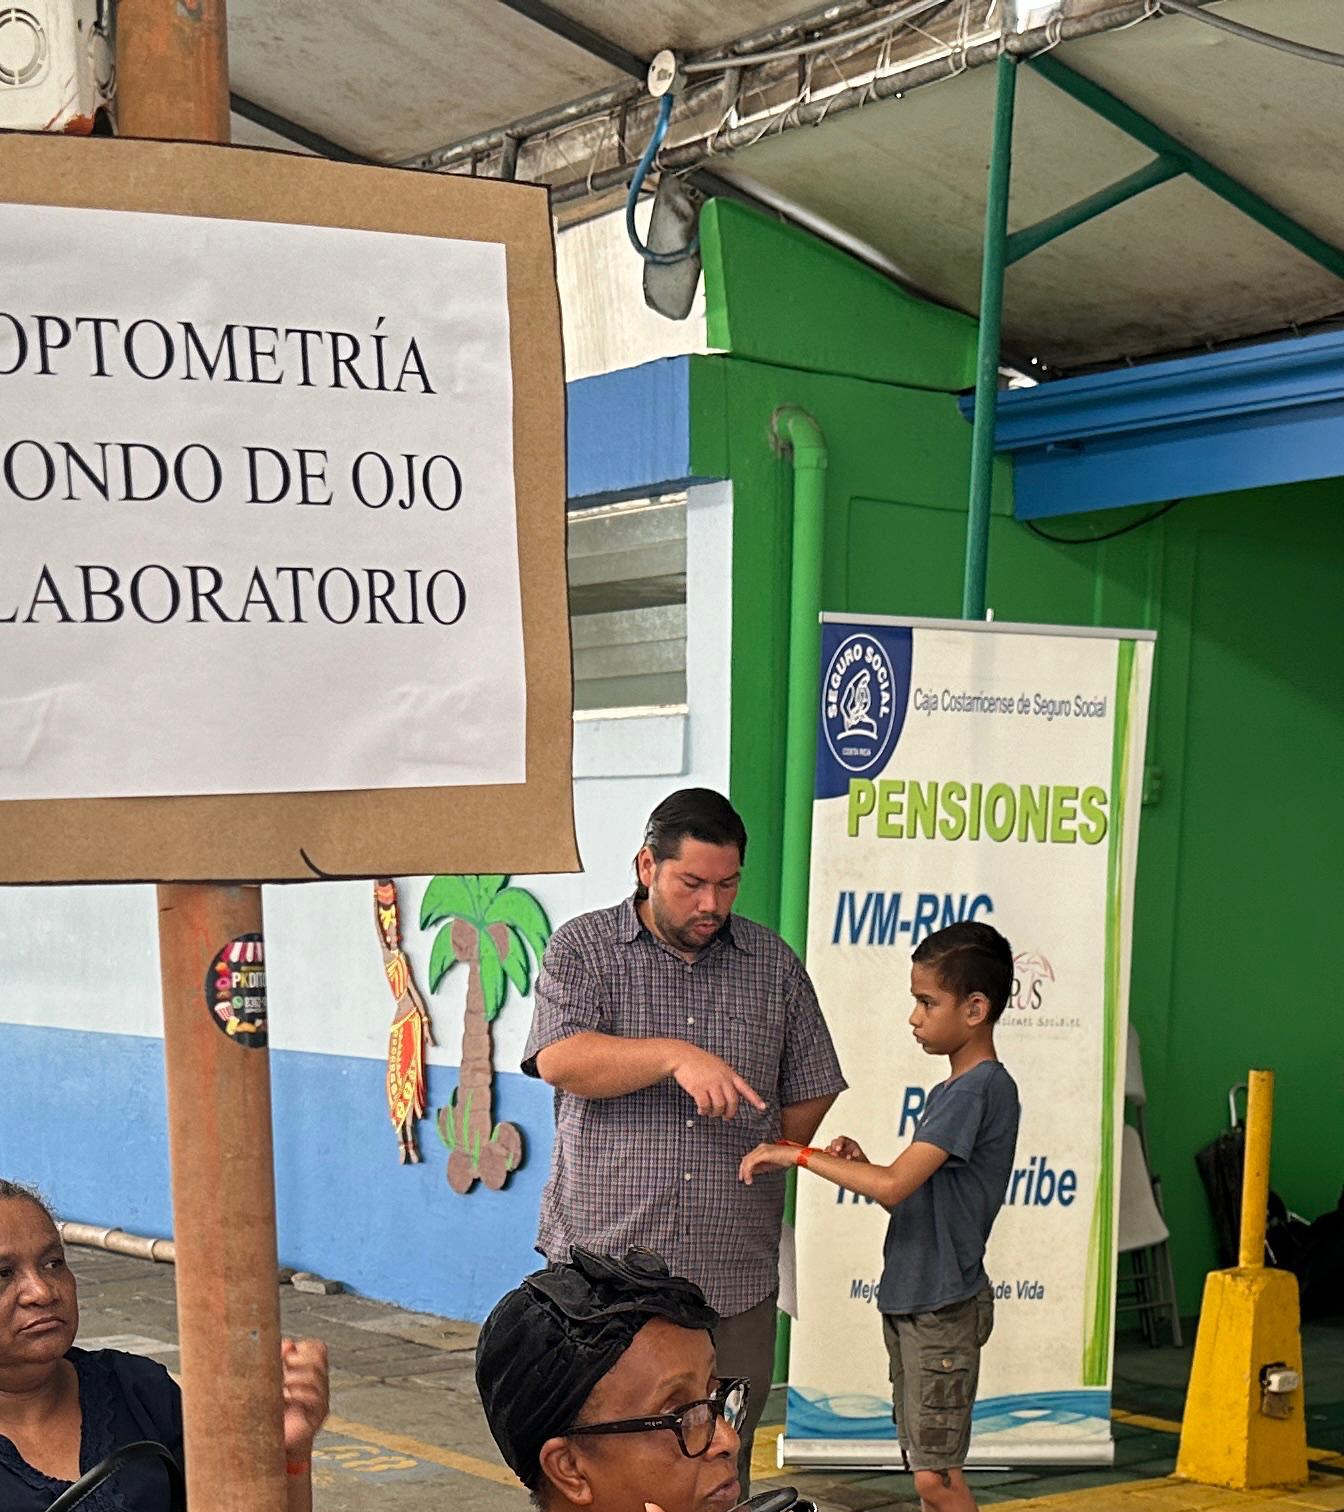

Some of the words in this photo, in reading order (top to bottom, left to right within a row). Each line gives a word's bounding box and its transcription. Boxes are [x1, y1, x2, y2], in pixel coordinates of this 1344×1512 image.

[242, 446, 333, 508] DE
[351, 451, 463, 513] OJO
[827, 644, 863, 719] SEGURO
[864, 646, 891, 718] SOCIAL
[913, 688, 938, 716] Caja
[1017, 693, 1030, 715] de
[1033, 693, 1071, 722] Seguro
[1074, 695, 1107, 718] Social
[847, 778, 1109, 845] PENSIONES
[1016, 1281, 1045, 1300] Vida
